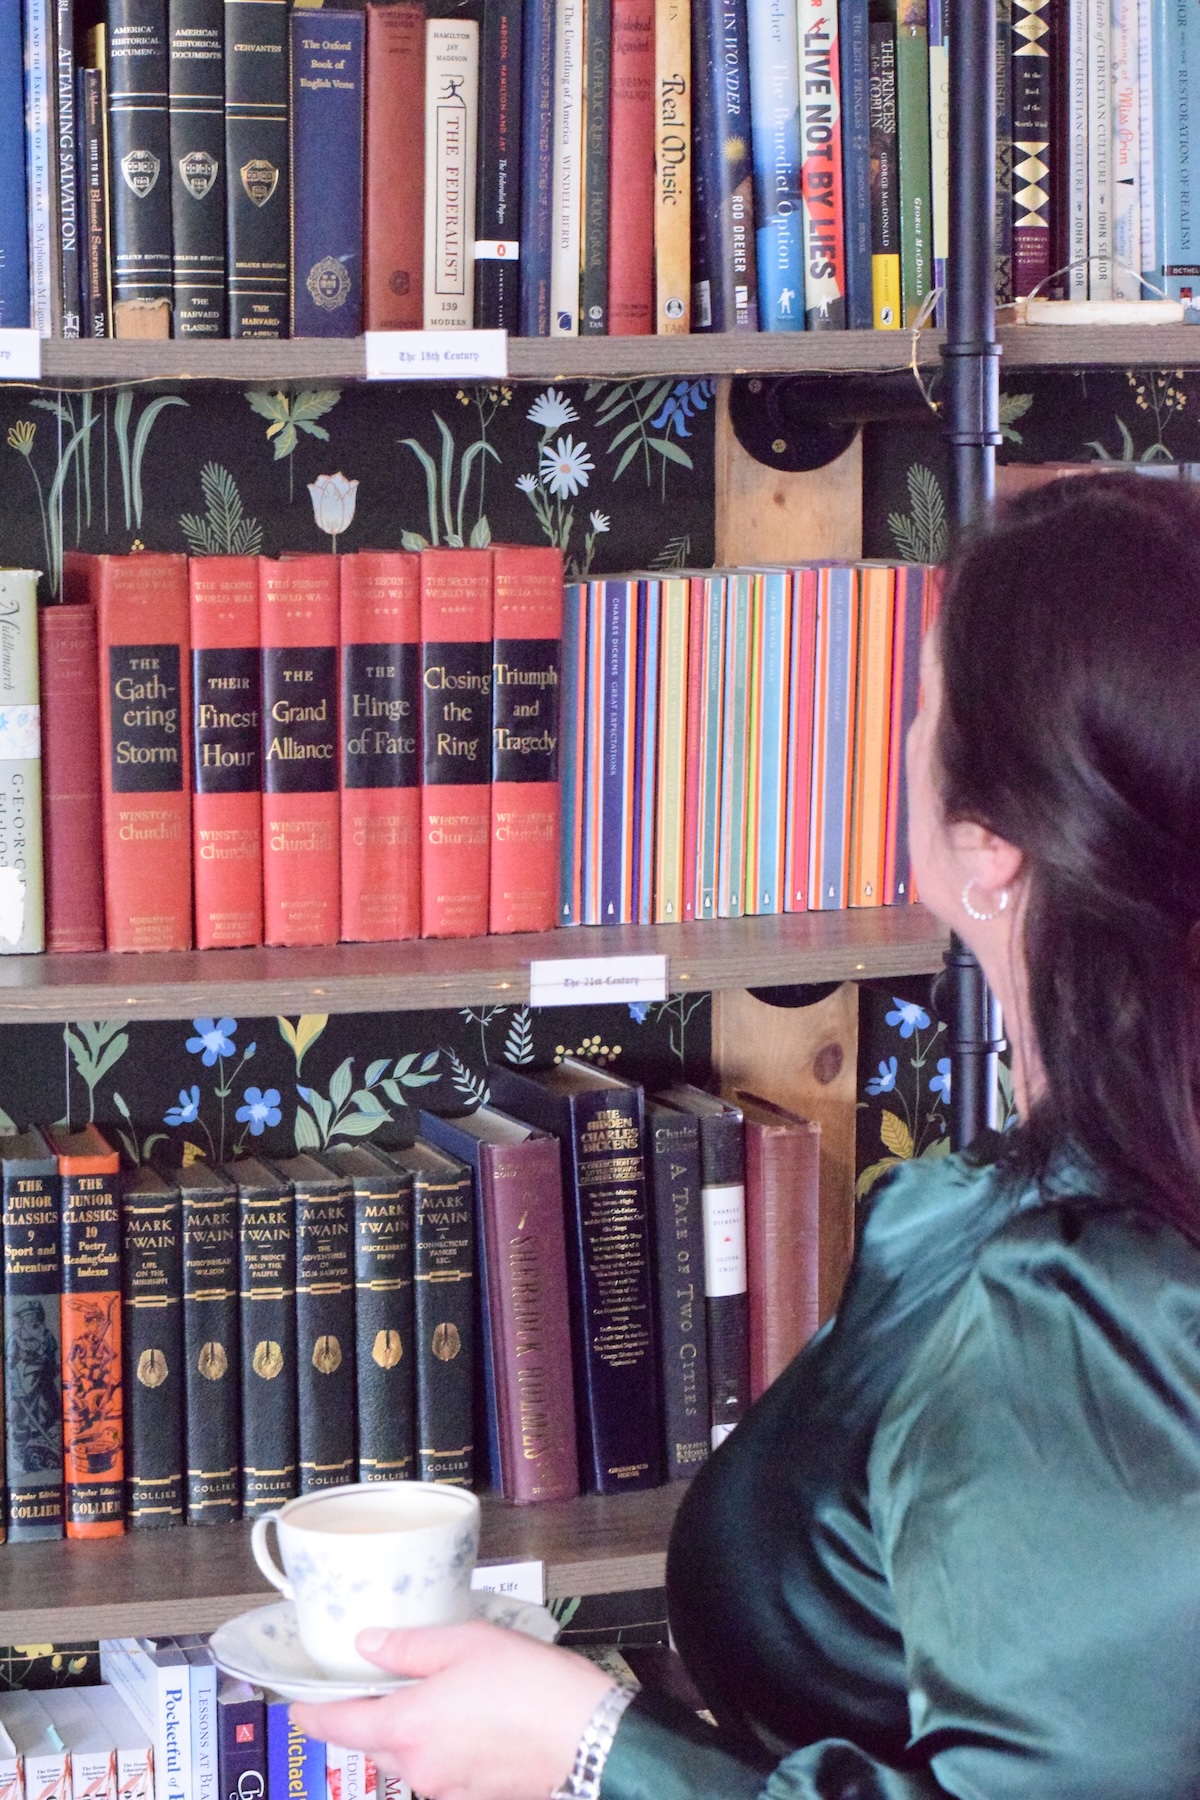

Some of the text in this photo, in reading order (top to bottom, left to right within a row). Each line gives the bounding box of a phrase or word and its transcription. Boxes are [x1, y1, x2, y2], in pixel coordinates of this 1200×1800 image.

[173, 40, 221, 48] HISTORICAL
[234, 44, 281, 52] CERVANTES
[302, 40, 351, 50] The Oxford
[310, 59, 345, 69] Book of
[300, 78, 354, 89] English Verse
[869, 44, 882, 129] and the GOBLIN
[880, 40, 896, 134] THE PRINCESS
[1096, 45, 1106, 120] CHRISTIAN
[1118, 6, 1133, 166] Awakening of Miss Prim
[34, 76, 42, 133] EXERCISES
[59, 48, 74, 149] ATTAINING
[560, 5, 574, 251] The Unsettling of America WENDELL BERRY
[35, 138, 42, 150] OF
[661, 74, 686, 206] Real Music
[724, 13, 746, 272] IN WONDER ROD DREHER
[804, 33, 836, 279] LIVE NOT BY LIES
[1097, 124, 1107, 186] CULTURE
[1178, 70, 1190, 250] RESTORATION OF REALISM
[91, 164, 98, 172] TO
[771, 62, 794, 270] The Benedict Option
[880, 152, 888, 189] GEORGE
[35, 165, 44, 212] RETREAT
[61, 153, 75, 251] SALVATION
[444, 117, 459, 282] THE FEDERALIST
[90, 189, 101, 232] Blessed
[914, 197, 922, 235] GEORGE
[1098, 211, 1107, 238] JOHN
[91, 236, 102, 298] Sacrament
[1098, 243, 1108, 281] SEIOR
[441, 303, 458, 311] 139
[94, 313, 105, 336] TAN
[399, 351, 479, 362] The 18th Century
[611, 598, 619, 635] CHARLES
[0, 600, 20, 691] Middlemarch
[130, 659, 160, 670] THE
[366, 666, 395, 678] THE
[208, 678, 250, 689] THEIR
[283, 670, 314, 682] THE
[424, 666, 492, 693] Closing
[493, 664, 558, 690] Triumph
[115, 679, 176, 701] Gath-
[610, 682, 618, 710] GREAT
[271, 700, 327, 722] Grand
[352, 695, 411, 719] Hinge
[443, 703, 472, 722] the
[513, 701, 540, 718] and
[123, 707, 177, 731] ering
[199, 704, 258, 728] Finest
[266, 737, 333, 760] Alliance
[348, 729, 416, 754] of Fate
[437, 734, 479, 760] Ring
[493, 728, 557, 754] Tragedy
[116, 741, 178, 763] Storm
[202, 743, 255, 767] Hour
[563, 979, 579, 988] The
[605, 976, 639, 985] Century
[18, 1180, 42, 1192] THE
[78, 1179, 103, 1190] THE
[8, 1196, 52, 1210] JUNIOR
[68, 1194, 113, 1208] JUNIOR
[422, 1196, 464, 1209] MARK
[63, 1210, 119, 1223] CLASSICS
[302, 1207, 345, 1221] MARK
[365, 1204, 405, 1217] MARK
[3, 1212, 58, 1225] CLASSICS
[127, 1220, 172, 1232] MARK
[187, 1213, 230, 1227] MARK
[242, 1213, 287, 1225] MARK
[418, 1212, 468, 1225] TWAIN
[85, 1226, 98, 1238] 10
[240, 1229, 290, 1241] TWAIN
[299, 1223, 349, 1237] TWAIN
[359, 1221, 409, 1234] TWAIN
[27, 1230, 35, 1242] 9
[125, 1236, 175, 1248] TWAIN
[184, 1229, 234, 1243] TWAIN
[4, 1243, 56, 1260] Sport and
[79, 1241, 107, 1252] Poetry
[716, 1255, 739, 1263] OLIVER
[5, 1262, 58, 1274] Adventure
[77, 1267, 108, 1277] Indexes
[670, 1163, 698, 1416] A TALE OF TWO CITIES
[427, 1461, 469, 1472] COLLIER
[193, 1483, 237, 1493] COLLIER
[247, 1480, 292, 1491] COLLIER
[307, 1475, 350, 1486] COLLIER
[132, 1490, 176, 1501] COLLIER
[10, 1504, 61, 1518] COLLIER
[72, 1501, 121, 1515] COLLIER
[499, 1582, 518, 1592] Life
[199, 1689, 211, 1748] LESSONS
[166, 1689, 182, 1788] Pocketful of
[200, 1753, 209, 1769] AT
